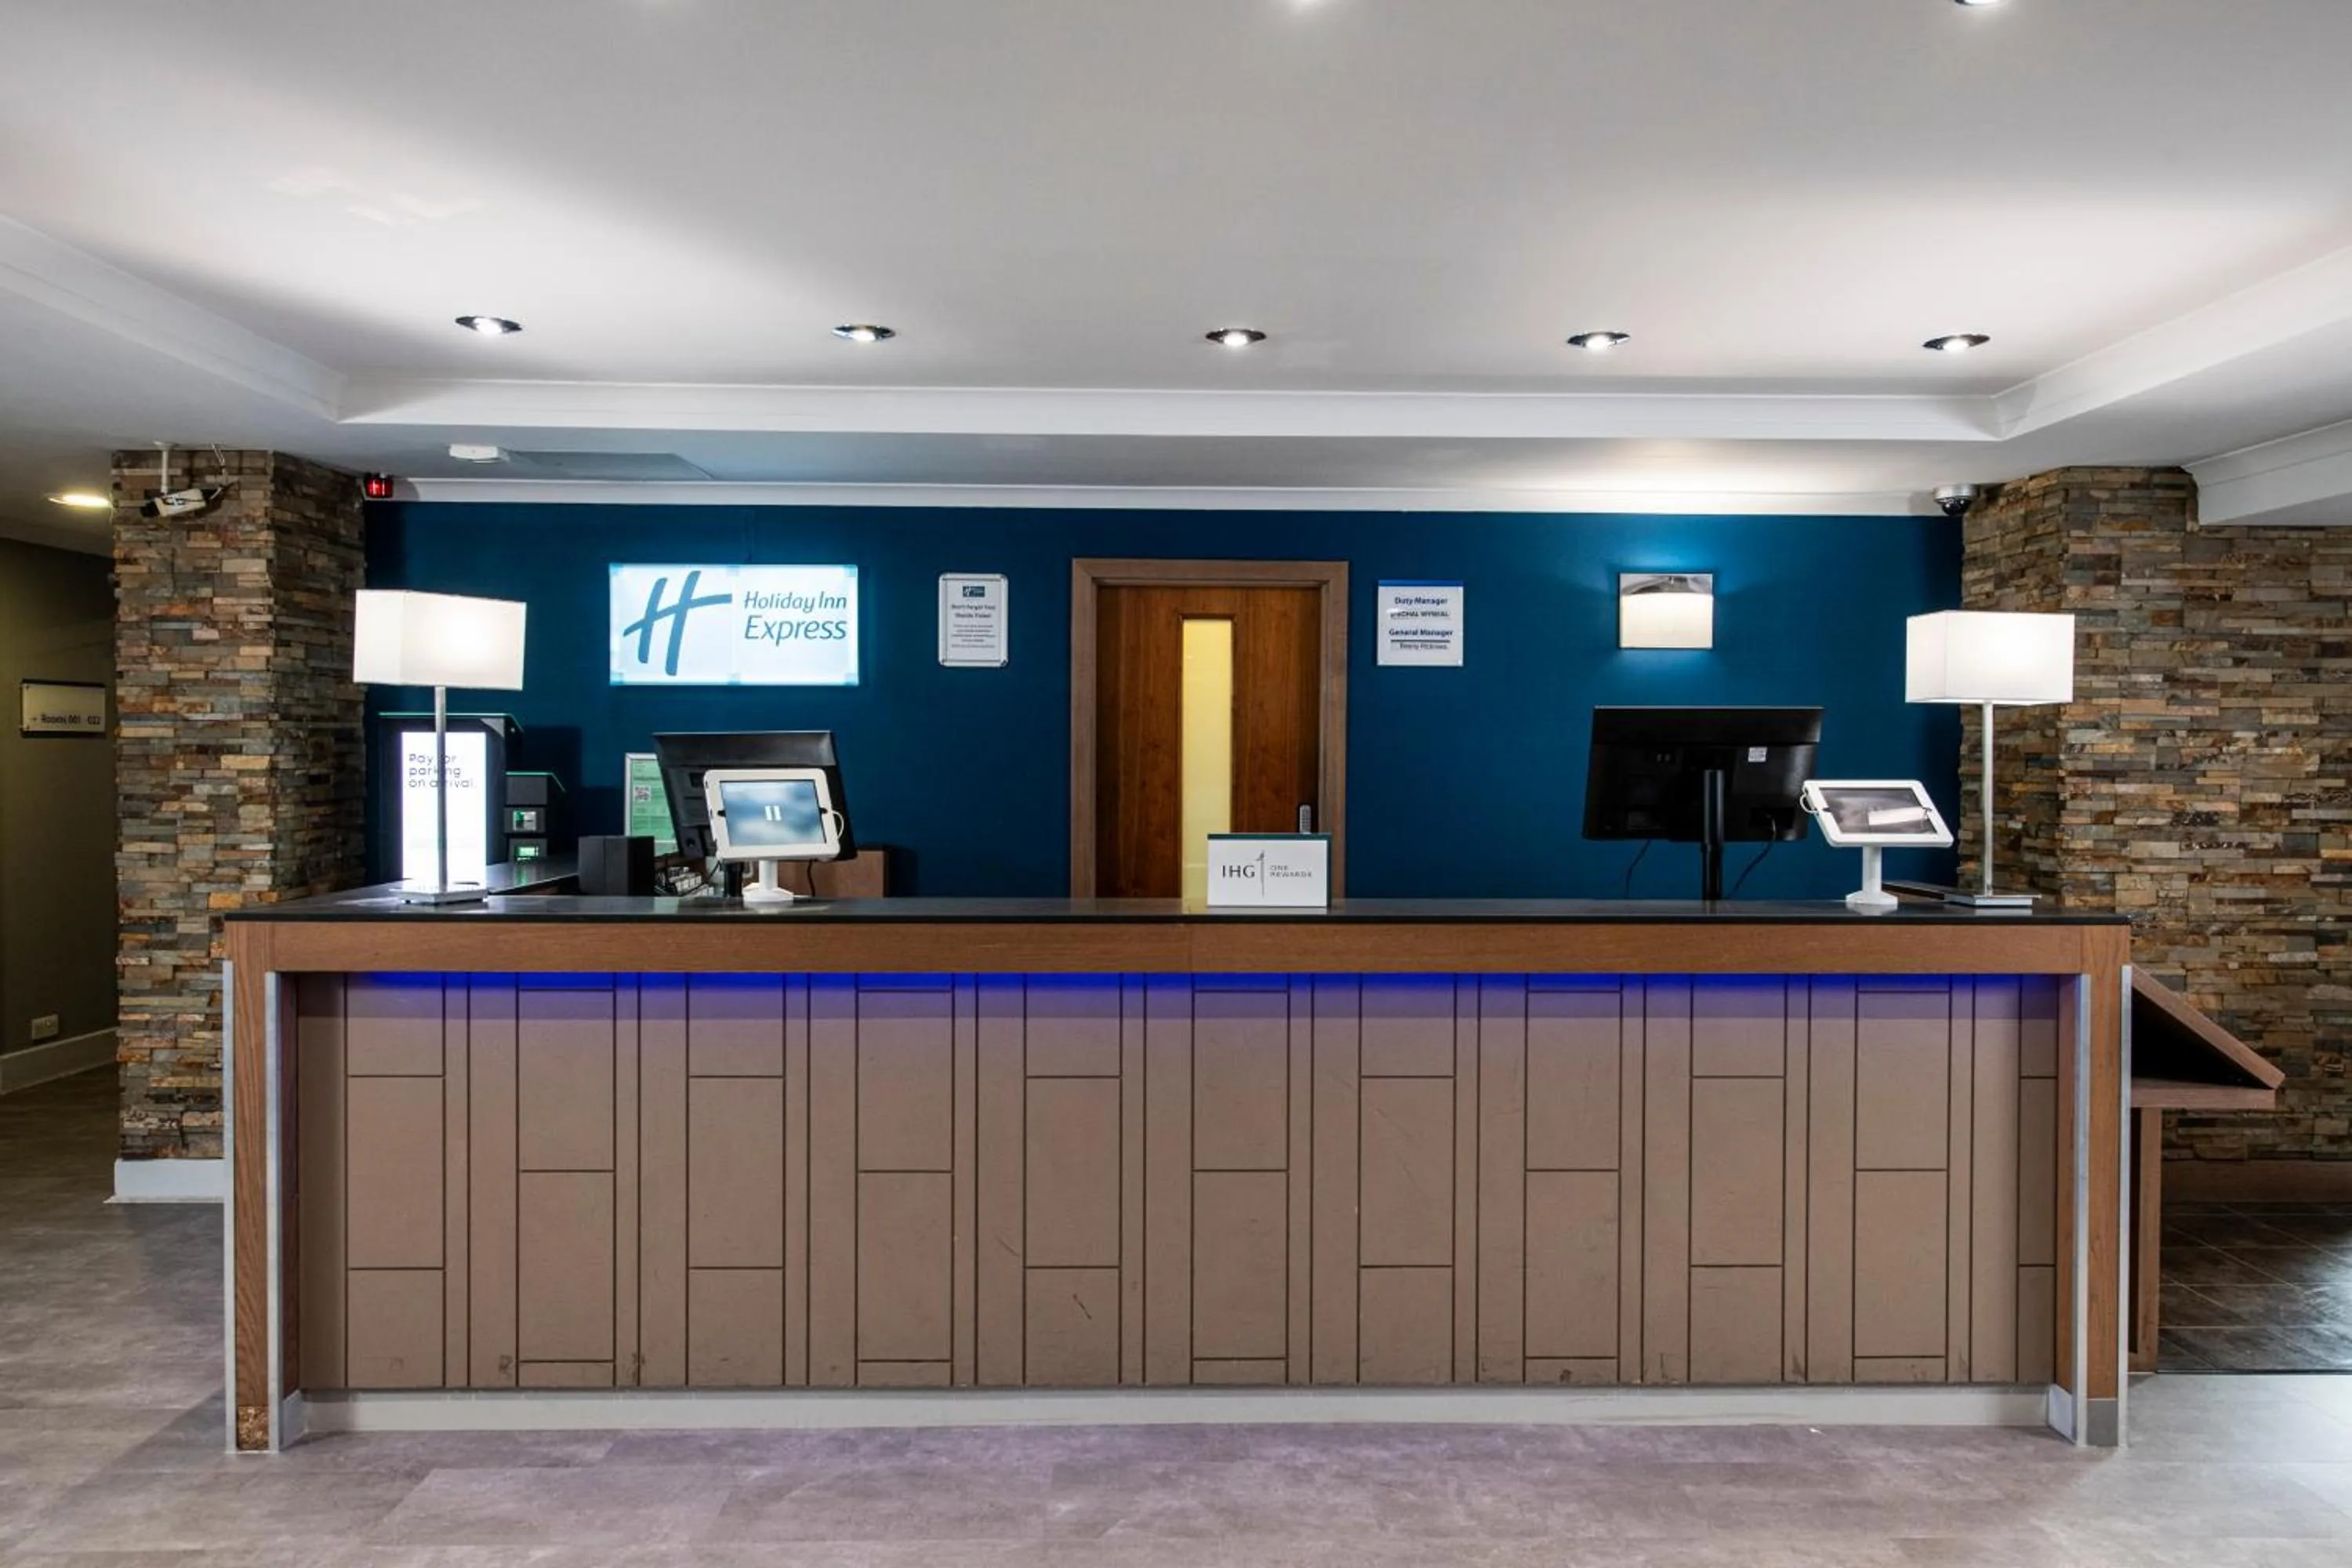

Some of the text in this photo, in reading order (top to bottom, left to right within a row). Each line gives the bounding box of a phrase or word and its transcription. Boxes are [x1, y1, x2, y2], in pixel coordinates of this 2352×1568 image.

[744, 591, 848, 613] Holiday Inn
[1414, 597, 1448, 605] Manager
[744, 615, 848, 647] Express
[408, 753, 434, 766] Pay
[408, 765, 461, 779] parkng
[408, 779, 426, 788] on
[1222, 865, 1254, 878] IHG
